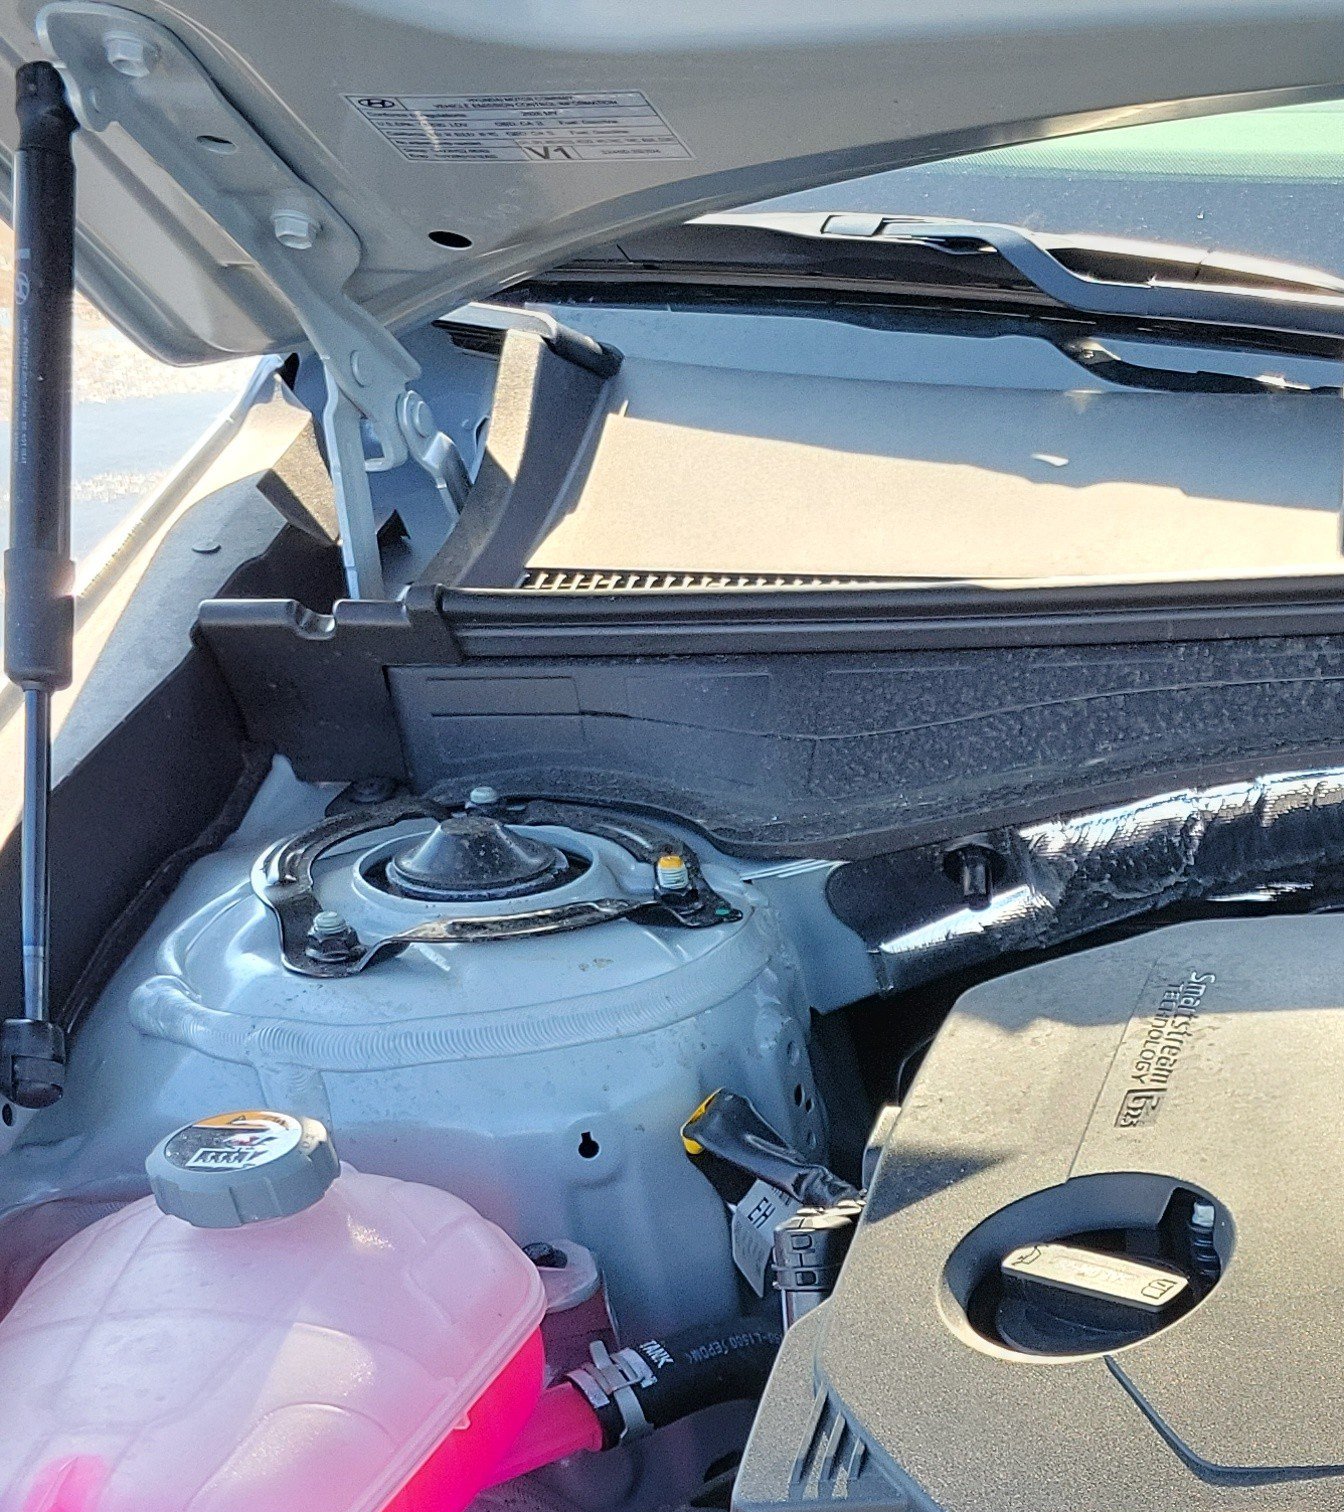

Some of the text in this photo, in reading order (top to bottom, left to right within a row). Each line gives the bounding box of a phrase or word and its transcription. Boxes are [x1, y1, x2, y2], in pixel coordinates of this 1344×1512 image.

[524, 145, 572, 160] V1
[1131, 981, 1185, 1084] TECHNOLOGY
[1150, 970, 1216, 1085] Smartstream
[747, 1196, 776, 1229] EH
[639, 1340, 674, 1369] TANK
